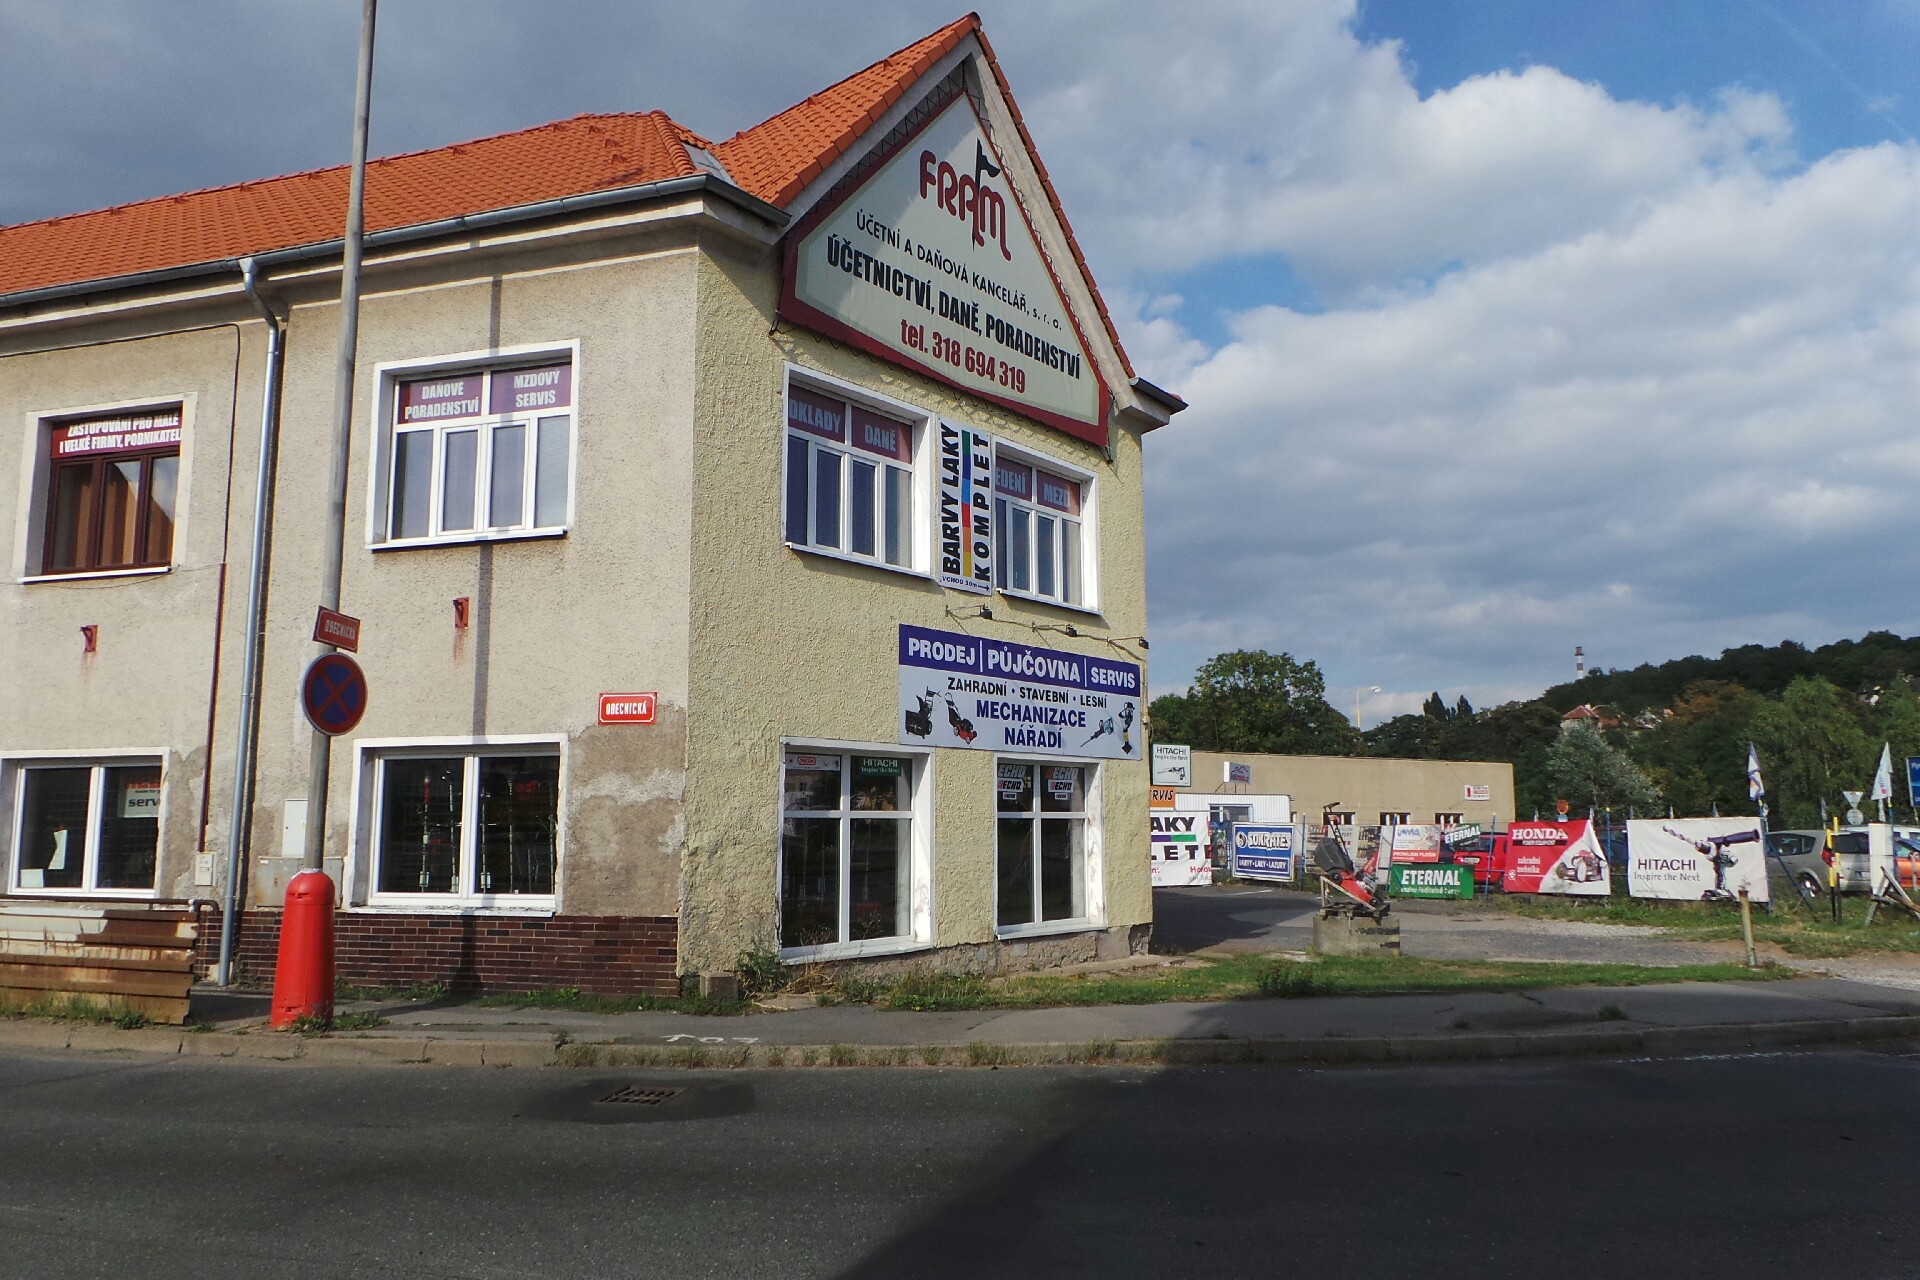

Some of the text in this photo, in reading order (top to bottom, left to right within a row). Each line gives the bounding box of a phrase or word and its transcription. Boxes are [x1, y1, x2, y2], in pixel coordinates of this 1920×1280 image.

[919, 150, 1012, 262] FRAM
[856, 208, 900, 249] ÚČETNÍ
[903, 238, 913, 256] A
[917, 244, 969, 283] DAŇOVÁ
[972, 272, 1030, 316] KANCELÁŘ,
[827, 232, 1081, 380] ÚČETNICTVÍ, DANĚ, PORADENSTVÍ
[900, 318, 1026, 394] tel. 318 694 319
[513, 368, 560, 389] MZDOVÝ
[421, 382, 464, 400] DAŇOVÉ
[515, 390, 556, 408] SERVIS
[404, 397, 480, 420] PORADENSTVÍ
[132, 416, 153, 431] PRO
[153, 412, 179, 428] MALÉ
[59, 441, 64, 454] I
[64, 435, 91, 453] VELKÉ
[91, 434, 124, 450] FIRMY,
[864, 423, 896, 452] DANĚ
[940, 421, 961, 576] BARVY LAKY
[972, 432, 991, 582] KOMPLET
[942, 575, 964, 585] VCHOD
[908, 637, 1136, 690] PRODEJ PŮJČOVNA SERVIS
[947, 676, 1108, 709] ZAHRADNÍ STAVEBNÍ LESNÍ
[605, 700, 648, 716] OBECNICKÁ
[976, 699, 1087, 728] MECHANIZACE
[1004, 723, 1063, 749] NÁŘADÍ
[1156, 747, 1186, 755] HITACHI
[863, 758, 898, 768] HITACHI
[997, 764, 1027, 779] ECHO
[1053, 767, 1080, 780] ECHO
[1002, 780, 1022, 790] ECHO
[1055, 781, 1073, 791] ECHO
[1150, 816, 1195, 832] AKY
[1247, 831, 1292, 849] SOKRATES
[1444, 825, 1481, 844] ETERNAL
[1511, 828, 1569, 840] HONDA
[1637, 858, 1696, 871] HITACHI
[1400, 869, 1461, 886] ETERNAL
[1633, 871, 1701, 882] Inspire the Next
